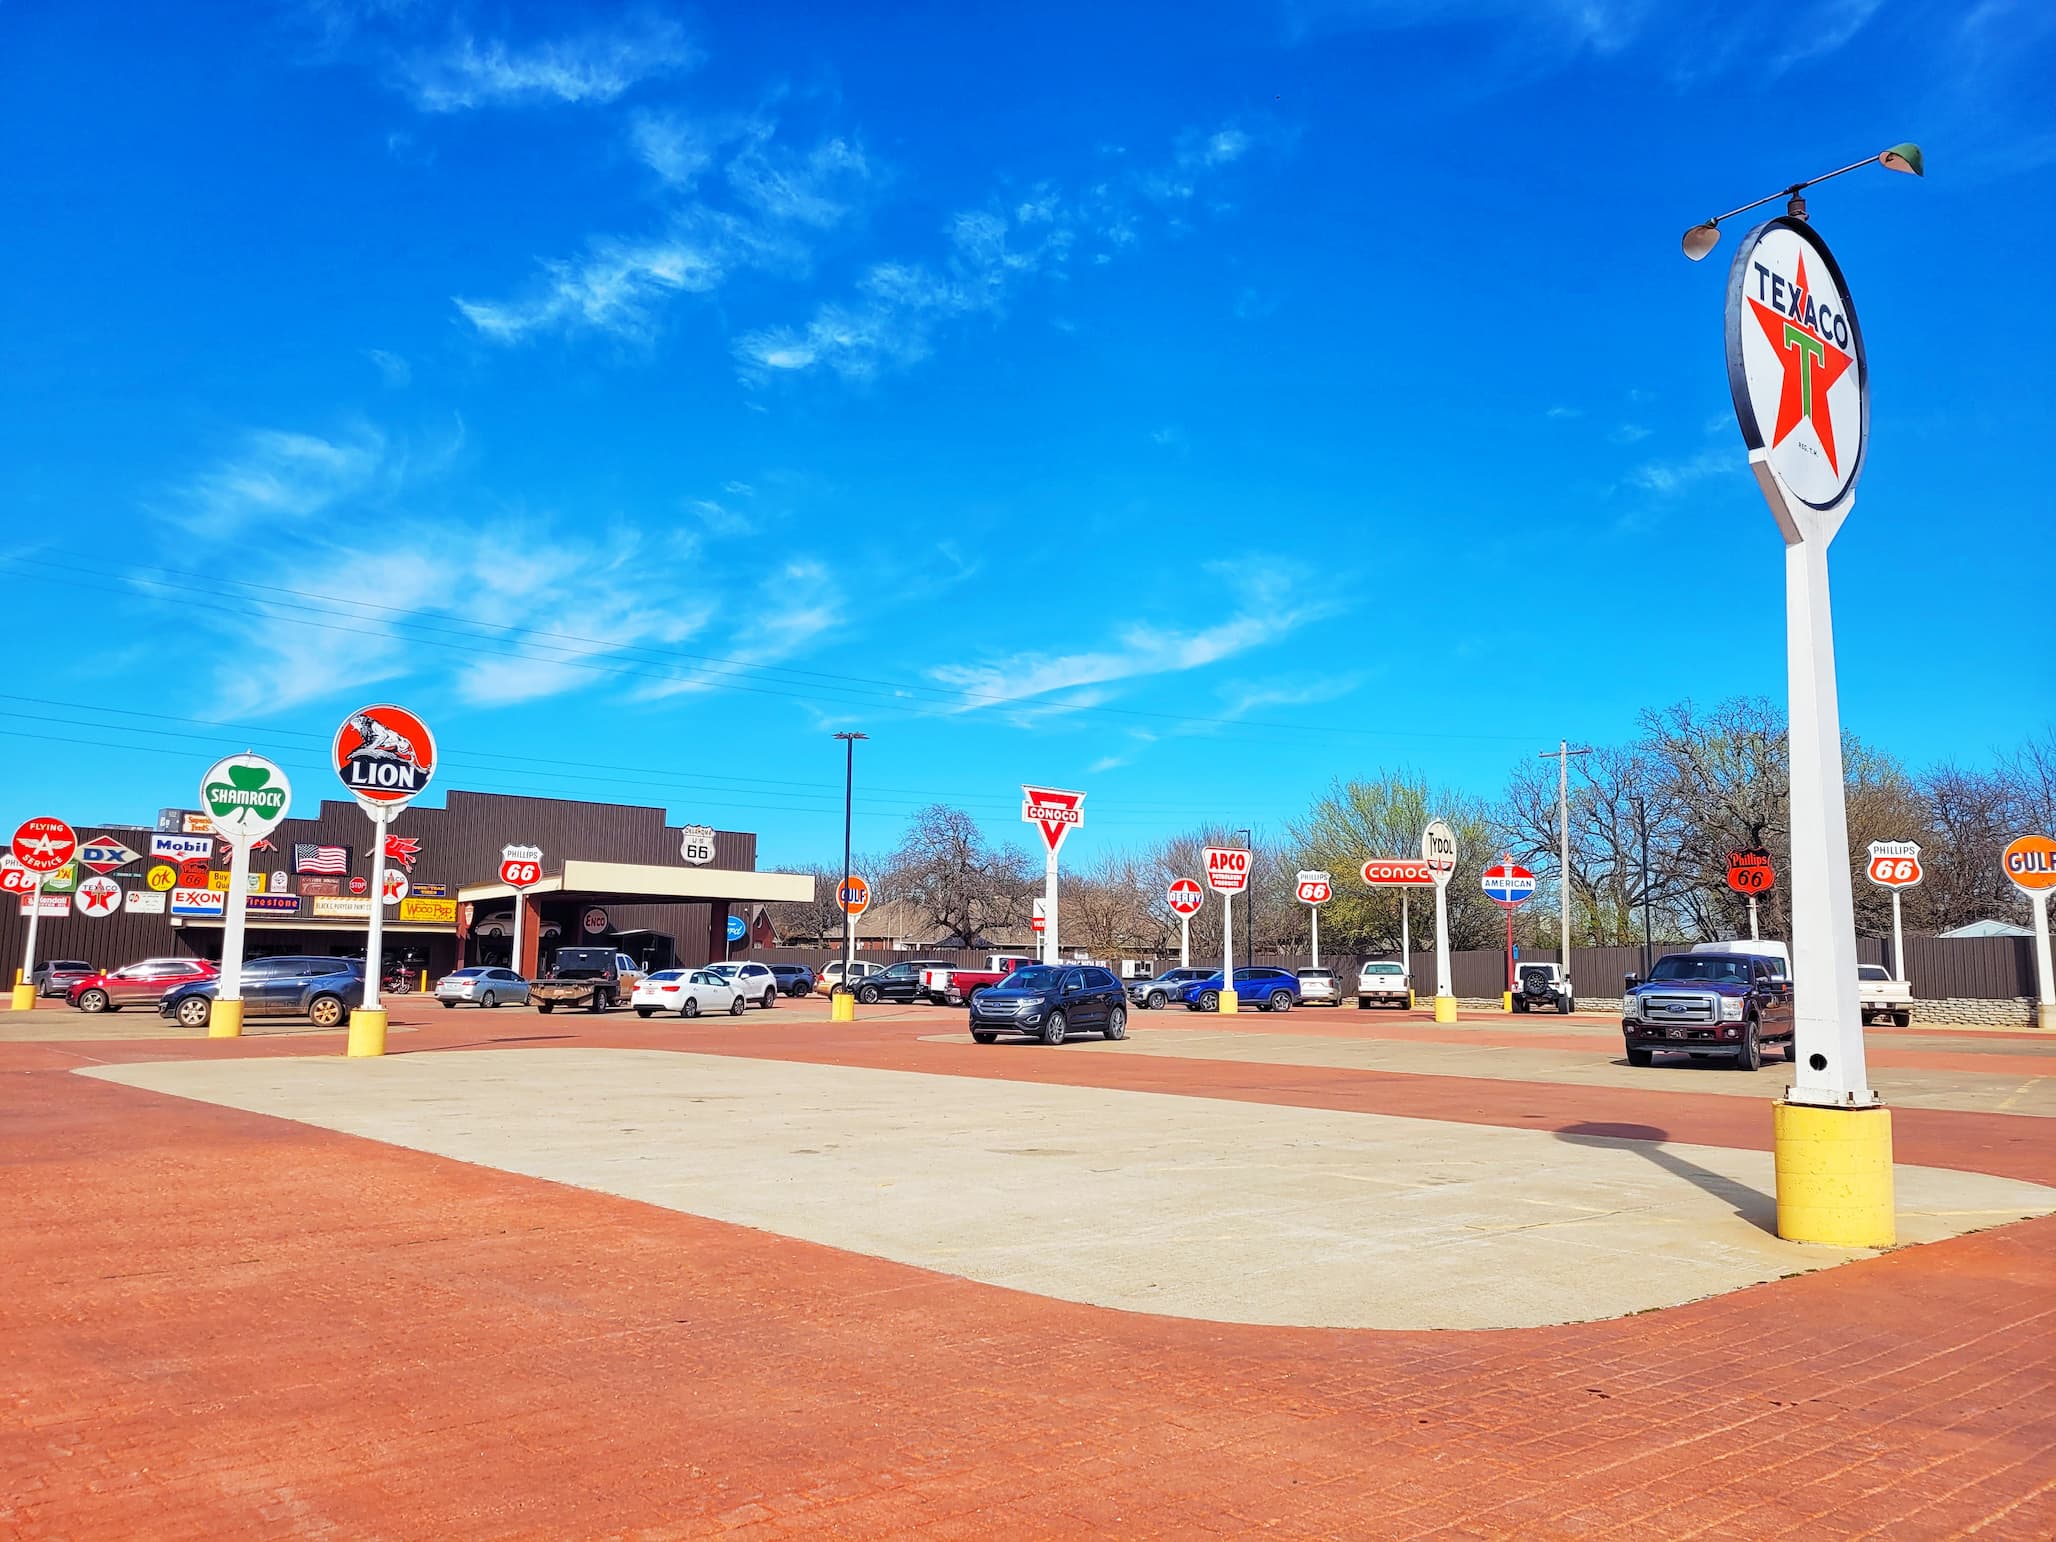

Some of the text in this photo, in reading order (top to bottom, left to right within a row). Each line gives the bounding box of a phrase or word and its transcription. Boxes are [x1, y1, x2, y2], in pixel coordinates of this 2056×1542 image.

[1754, 261, 1848, 350] TEXACO
[351, 761, 415, 788] LION
[210, 788, 282, 807] SHAMROCK
[1030, 807, 1077, 822] CONOCO
[29, 823, 64, 832] FLYING
[156, 839, 208, 852] Mobil
[687, 845, 708, 859] 66
[1873, 846, 1915, 855] PHILLIPS
[22, 854, 63, 869] SERVICE
[83, 848, 127, 862] DX
[507, 850, 538, 859] PHILLIPS
[1209, 853, 1245, 871] APCO
[1731, 851, 1768, 867] Phillips
[2008, 851, 2056, 873] GULF
[214, 872, 229, 881] Buy
[506, 863, 536, 882] 66
[1875, 860, 1914, 880] 66
[3, 872, 37, 889] 66
[151, 869, 171, 887] OK
[186, 874, 202, 887] 66
[1485, 879, 1532, 888] AMERICAN
[1738, 870, 1764, 887] 66
[175, 891, 221, 907] EXXON
[1169, 892, 1202, 902] DERBY
[1301, 884, 1327, 899] 66
[585, 915, 605, 927] ENCO
